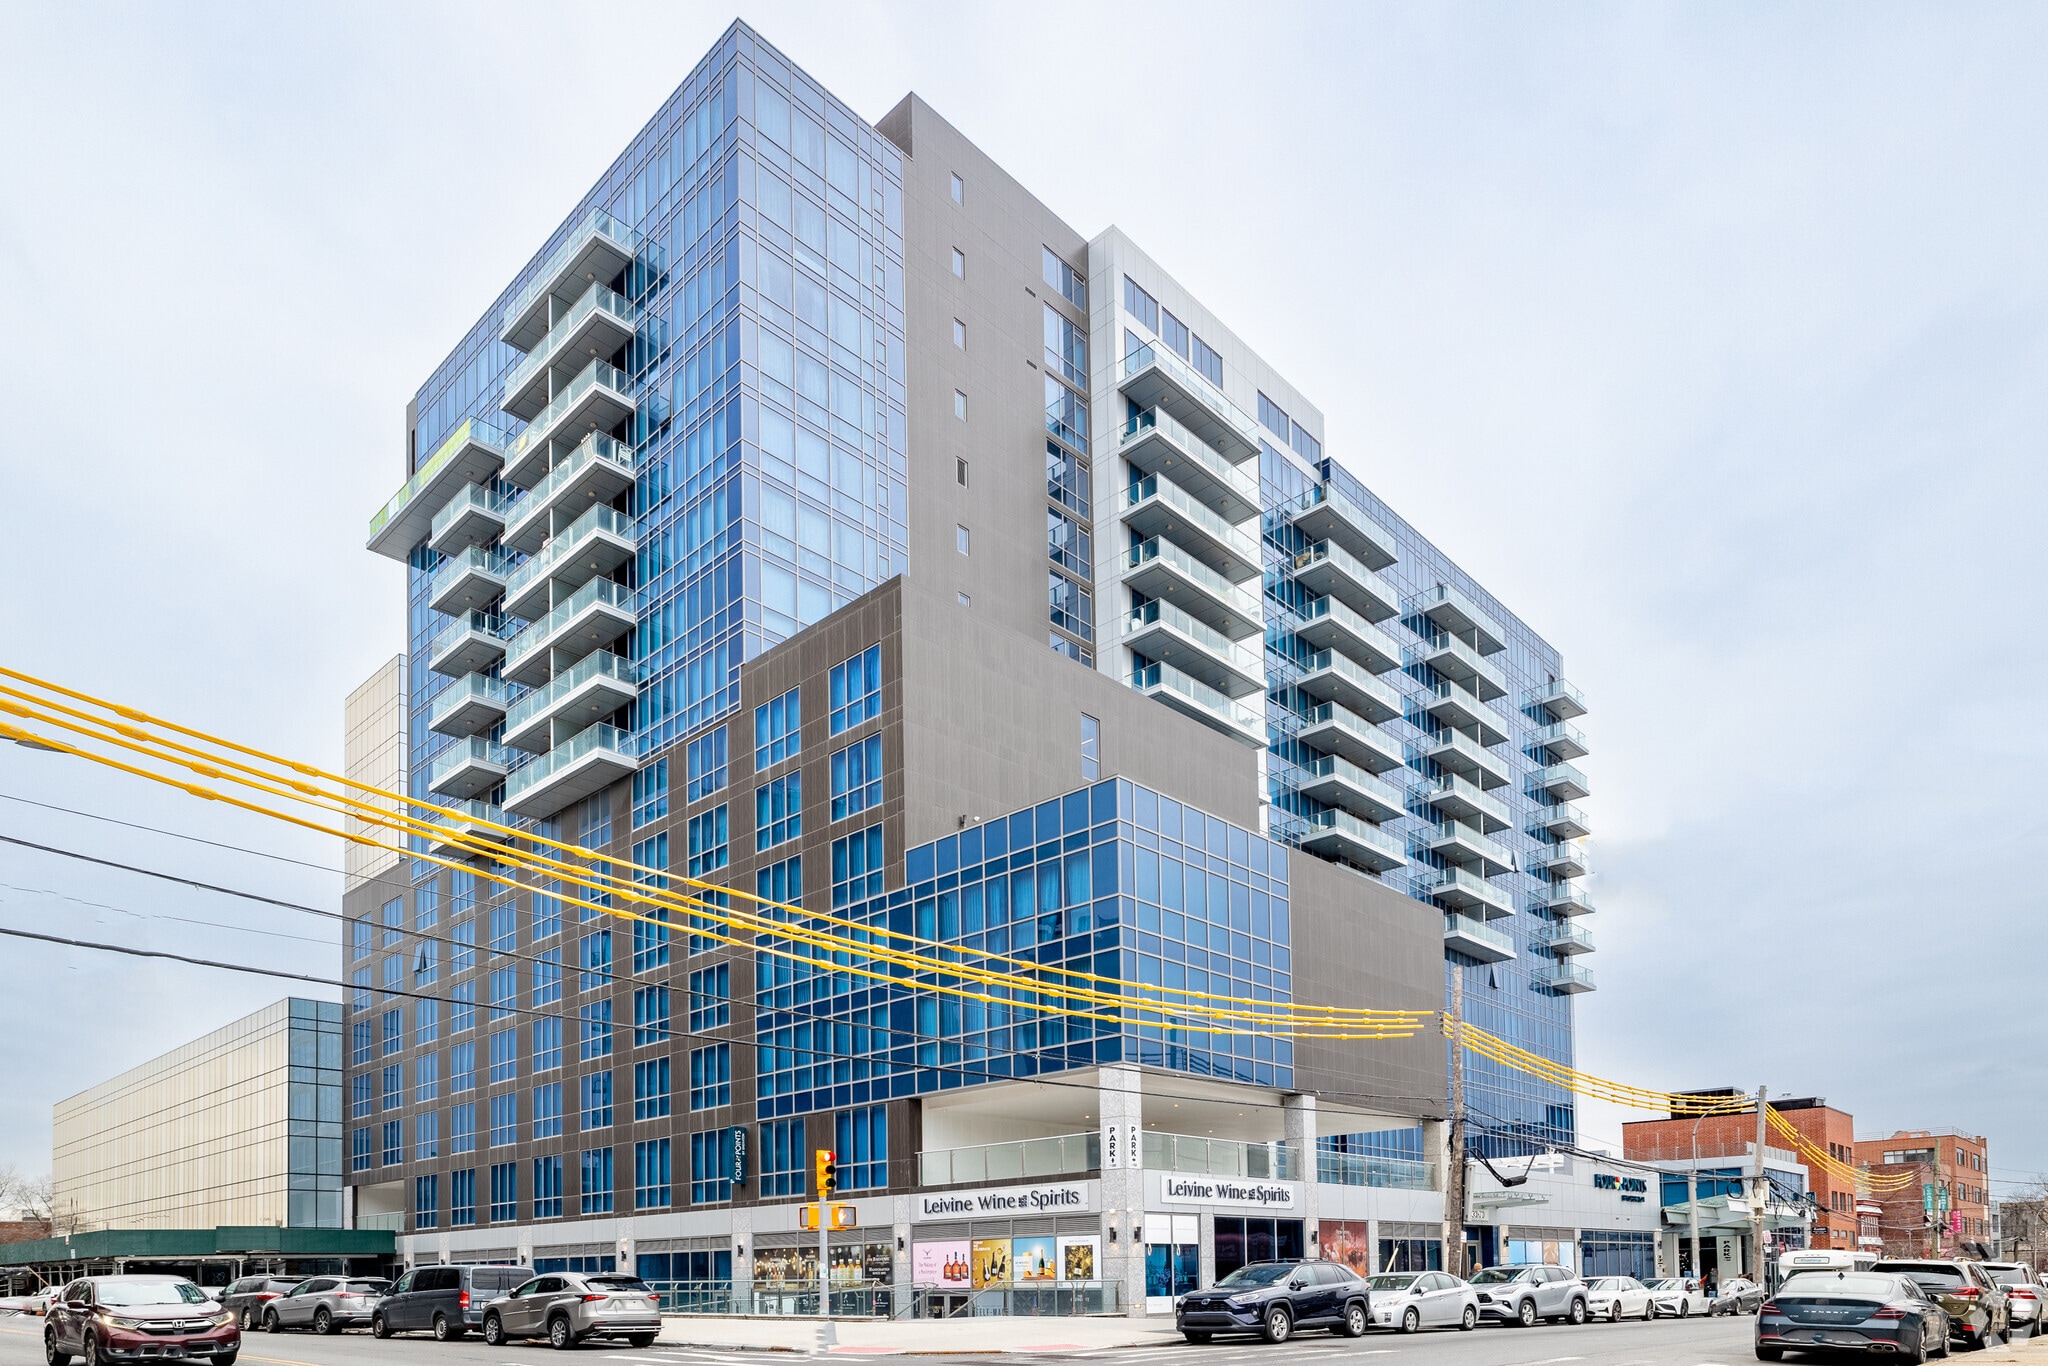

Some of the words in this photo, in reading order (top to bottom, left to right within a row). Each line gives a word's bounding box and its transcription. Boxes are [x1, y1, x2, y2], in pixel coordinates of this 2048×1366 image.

[924, 1197, 973, 1214] Leivine
[978, 1194, 1016, 1210] Wine
[1030, 1189, 1080, 1210] Spirits
[1168, 1179, 1213, 1198] Leivine
[1216, 1184, 1248, 1200] Wine
[1256, 1185, 1290, 1205] Spirits
